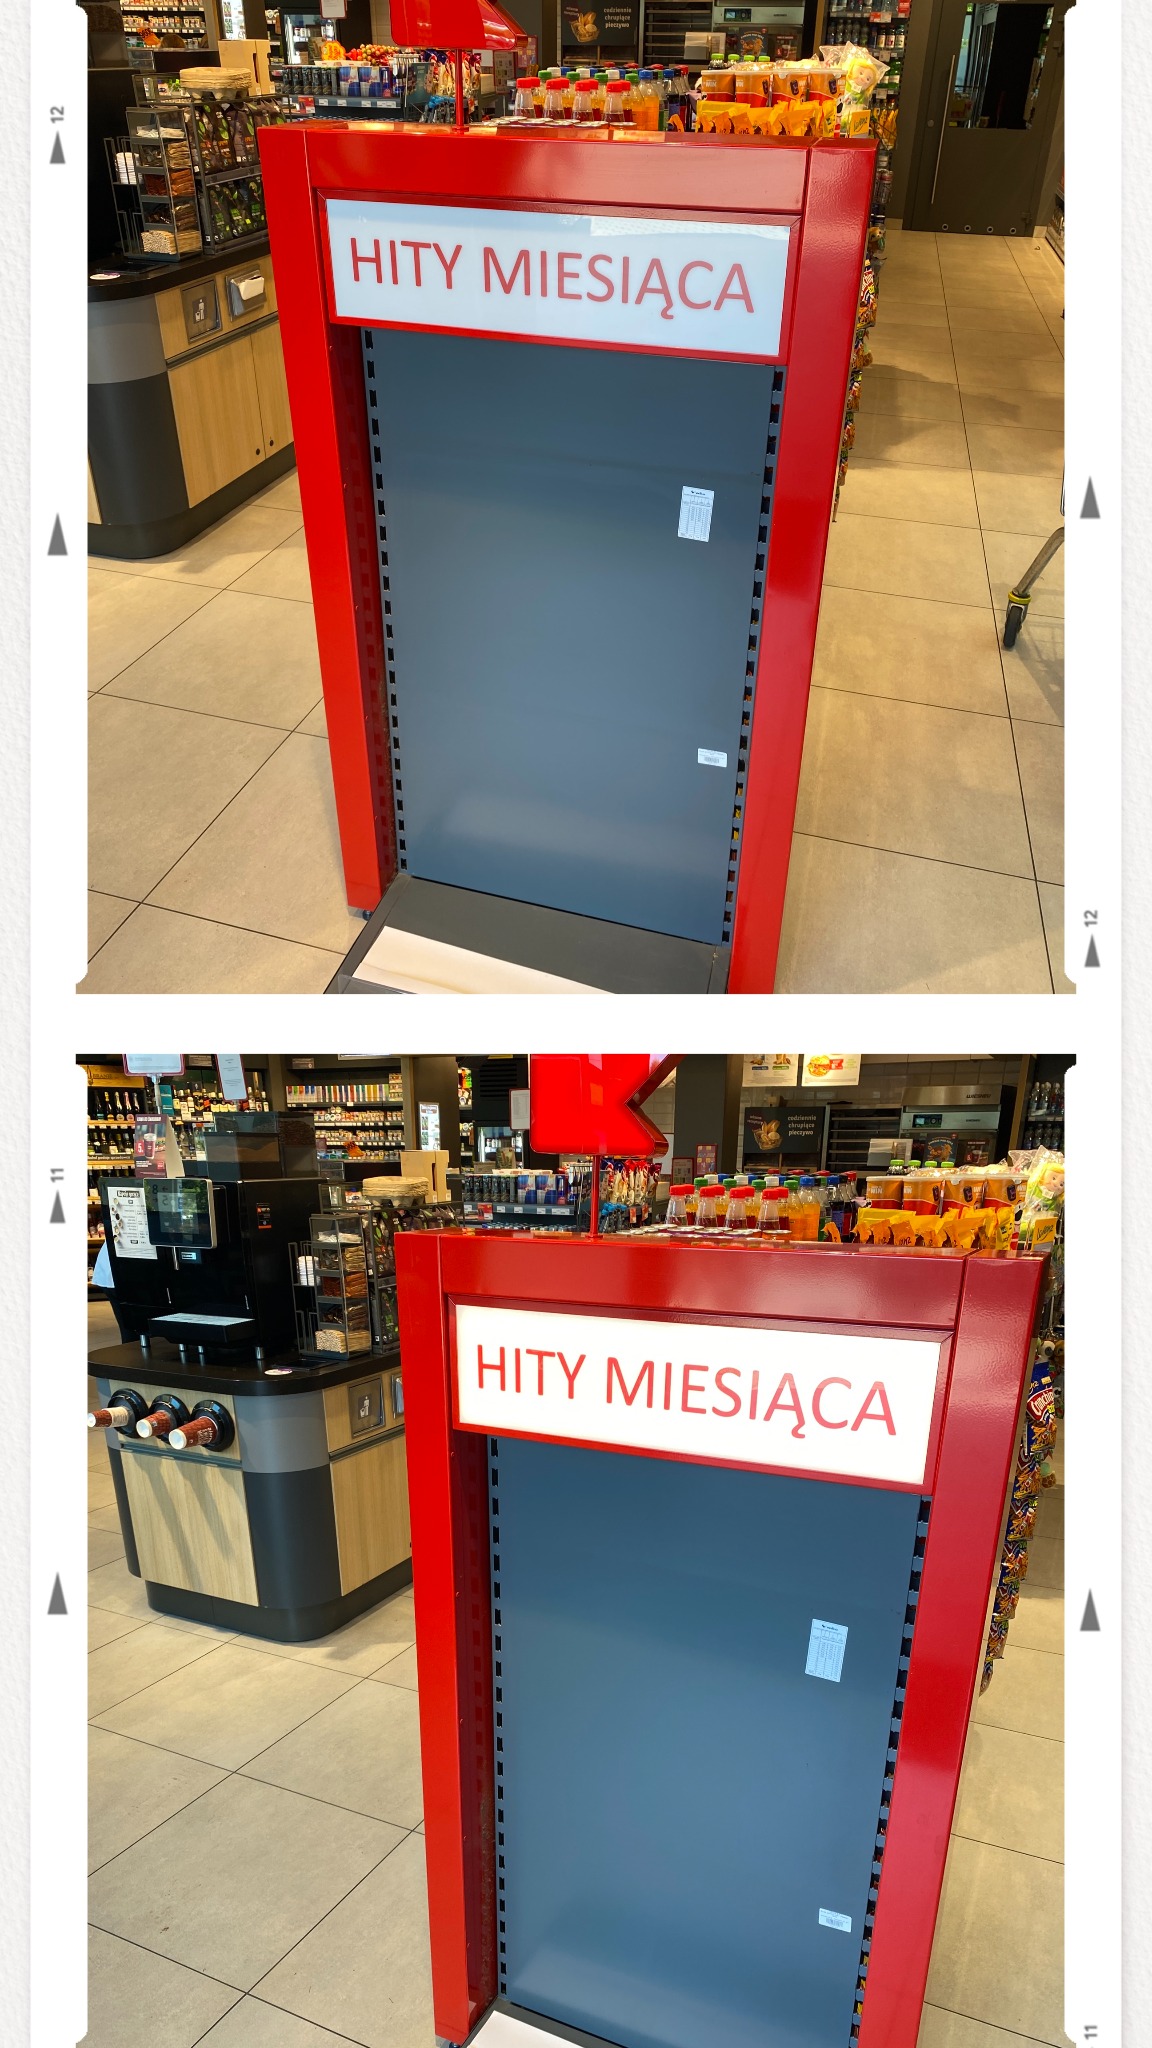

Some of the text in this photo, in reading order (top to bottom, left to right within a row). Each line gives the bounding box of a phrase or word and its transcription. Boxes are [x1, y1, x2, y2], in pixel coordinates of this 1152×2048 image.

[350, 237, 755, 320] HITY MIESIĄCA
[477, 1344, 897, 1439] HITY MIESIĄCA
